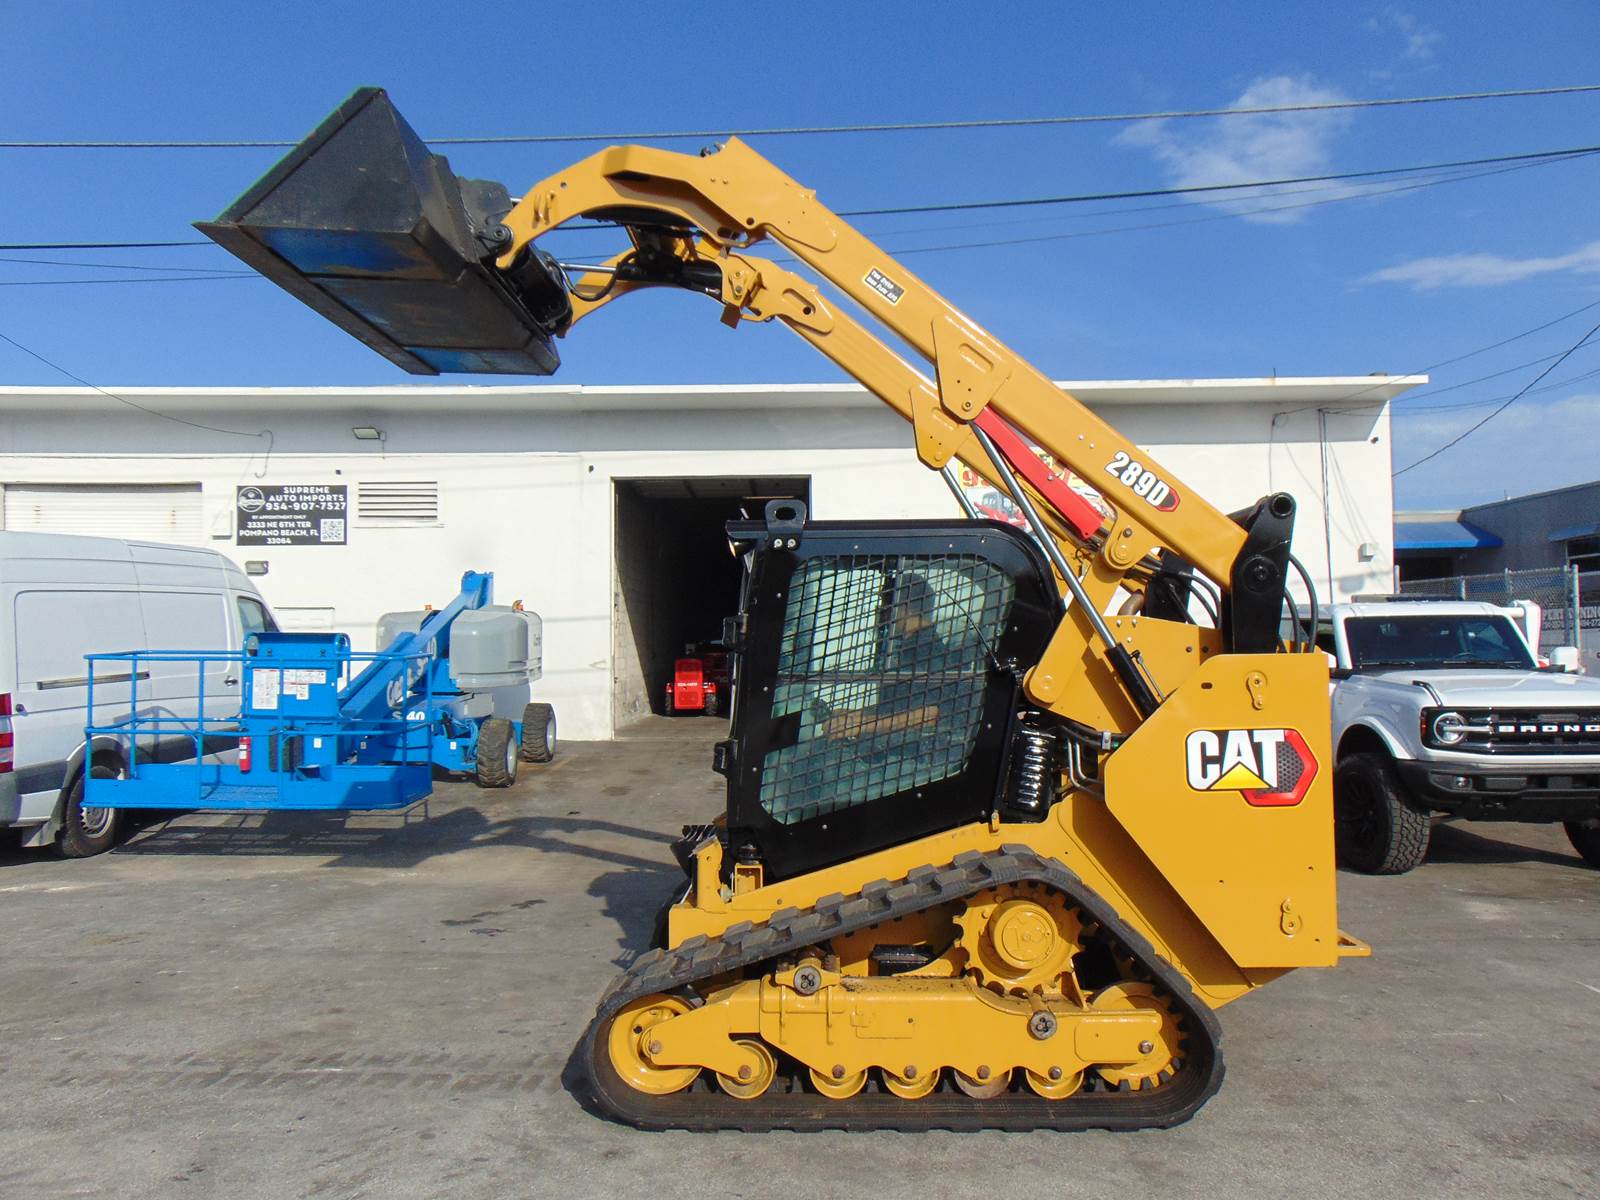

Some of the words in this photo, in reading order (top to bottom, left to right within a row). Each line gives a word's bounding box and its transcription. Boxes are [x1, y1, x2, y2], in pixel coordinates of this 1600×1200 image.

[1104, 451, 1170, 506] 289D
[283, 486, 330, 494] SUPREME
[268, 494, 297, 502] AUTO
[299, 494, 345, 502] IMPORTS
[265, 502, 347, 511] 954-907-7527
[239, 529, 279, 537] POMPANO
[280, 529, 309, 537] BEACH,
[1186, 729, 1285, 790] CAT
